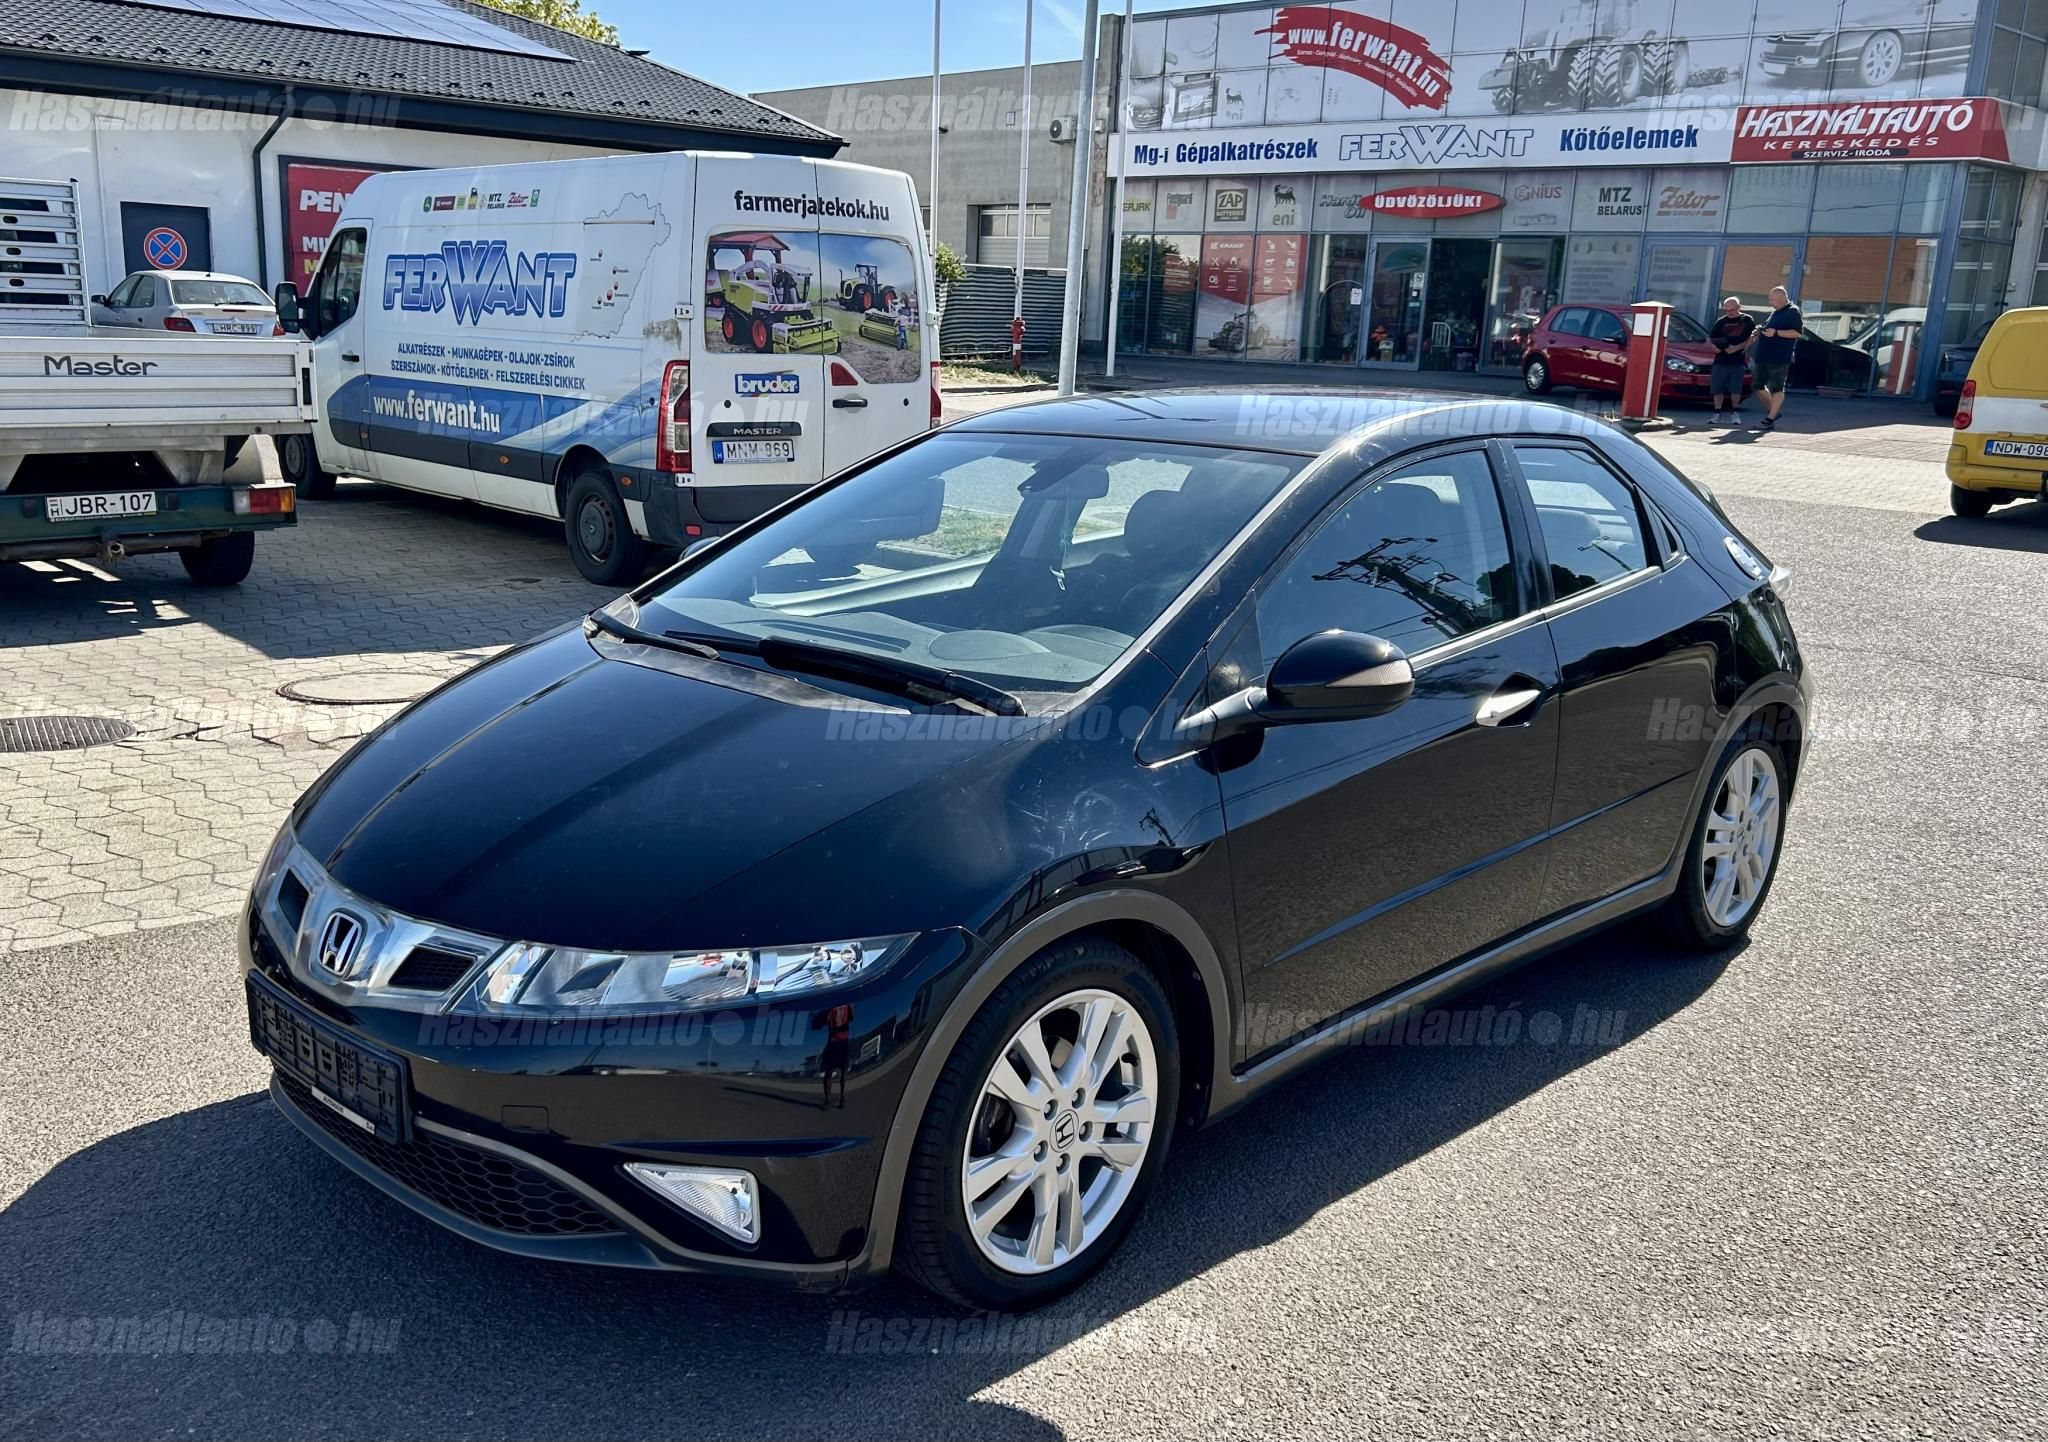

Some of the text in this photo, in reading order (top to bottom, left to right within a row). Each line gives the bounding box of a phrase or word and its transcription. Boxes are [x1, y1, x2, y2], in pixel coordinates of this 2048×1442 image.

[1288, 22, 1441, 97] www.ferwant.hu
[1739, 100, 1974, 138] HASZNÁLTAUTÓ
[1339, 124, 1534, 165] FERWANT
[1559, 125, 1699, 152] Kötőelemek
[1763, 136, 1940, 151] KERESKEDÉS
[1133, 138, 1319, 166] Mg-i Gépalkatrészek
[1803, 148, 1891, 159] SZERVIZ-IRODA
[488, 193, 502, 202] MTZ
[1218, 193, 1243, 208] ZAP
[1374, 193, 1482, 209] ÜDVÖZÖLJÜK!
[1598, 186, 1632, 202] MTZ
[1658, 186, 1721, 209] Zetor
[734, 190, 890, 221] farmerjatekok.hu
[1597, 205, 1642, 216] BELARUS
[1272, 209, 1295, 226] eni
[383, 240, 577, 326] FERWANT
[397, 342, 446, 357] ALKATRÉSZEK
[451, 346, 504, 363] MUNKAGÉPEK
[44, 354, 158, 377] Master
[495, 369, 553, 387] FELSZERELÉSI
[554, 375, 586, 390] CIKKEK
[737, 375, 798, 393] bruder
[373, 389, 501, 433] www.ferwant.hu
[65, 494, 152, 515] JBR-107
